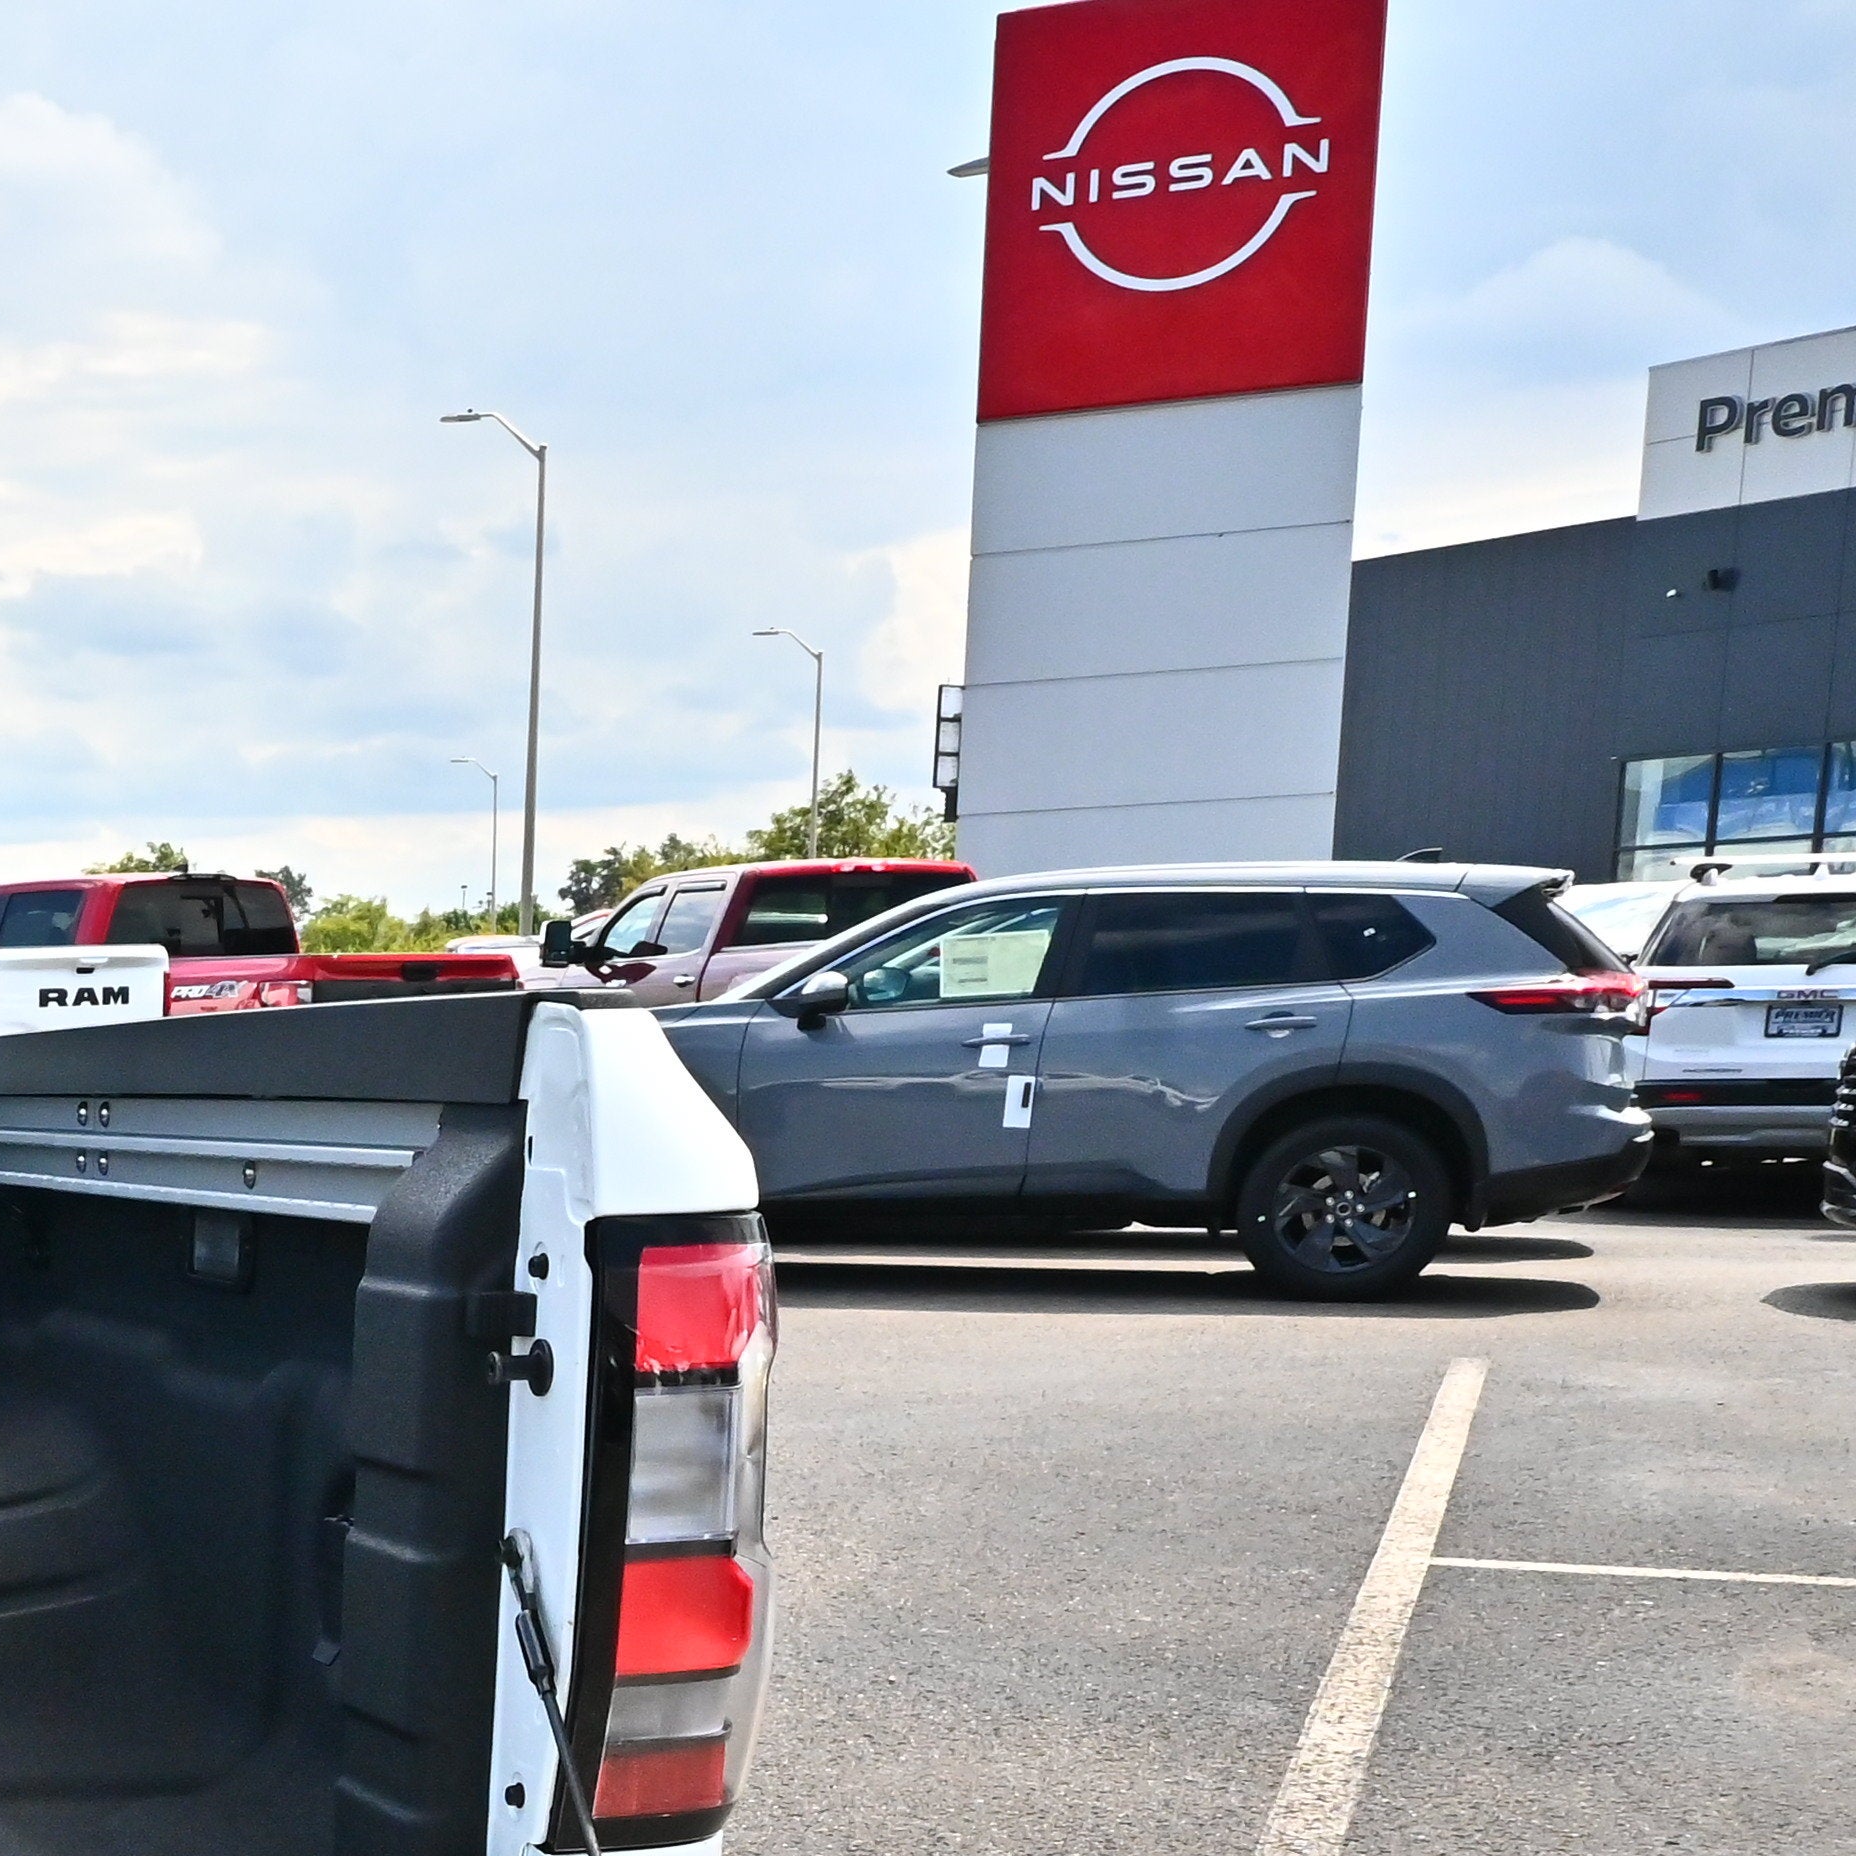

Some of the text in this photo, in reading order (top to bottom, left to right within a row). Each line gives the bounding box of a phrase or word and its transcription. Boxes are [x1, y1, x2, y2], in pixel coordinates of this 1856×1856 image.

[1030, 138, 1330, 211] NISSAN
[38, 986, 130, 1008] RAM
[1777, 989, 1839, 999] GMC
